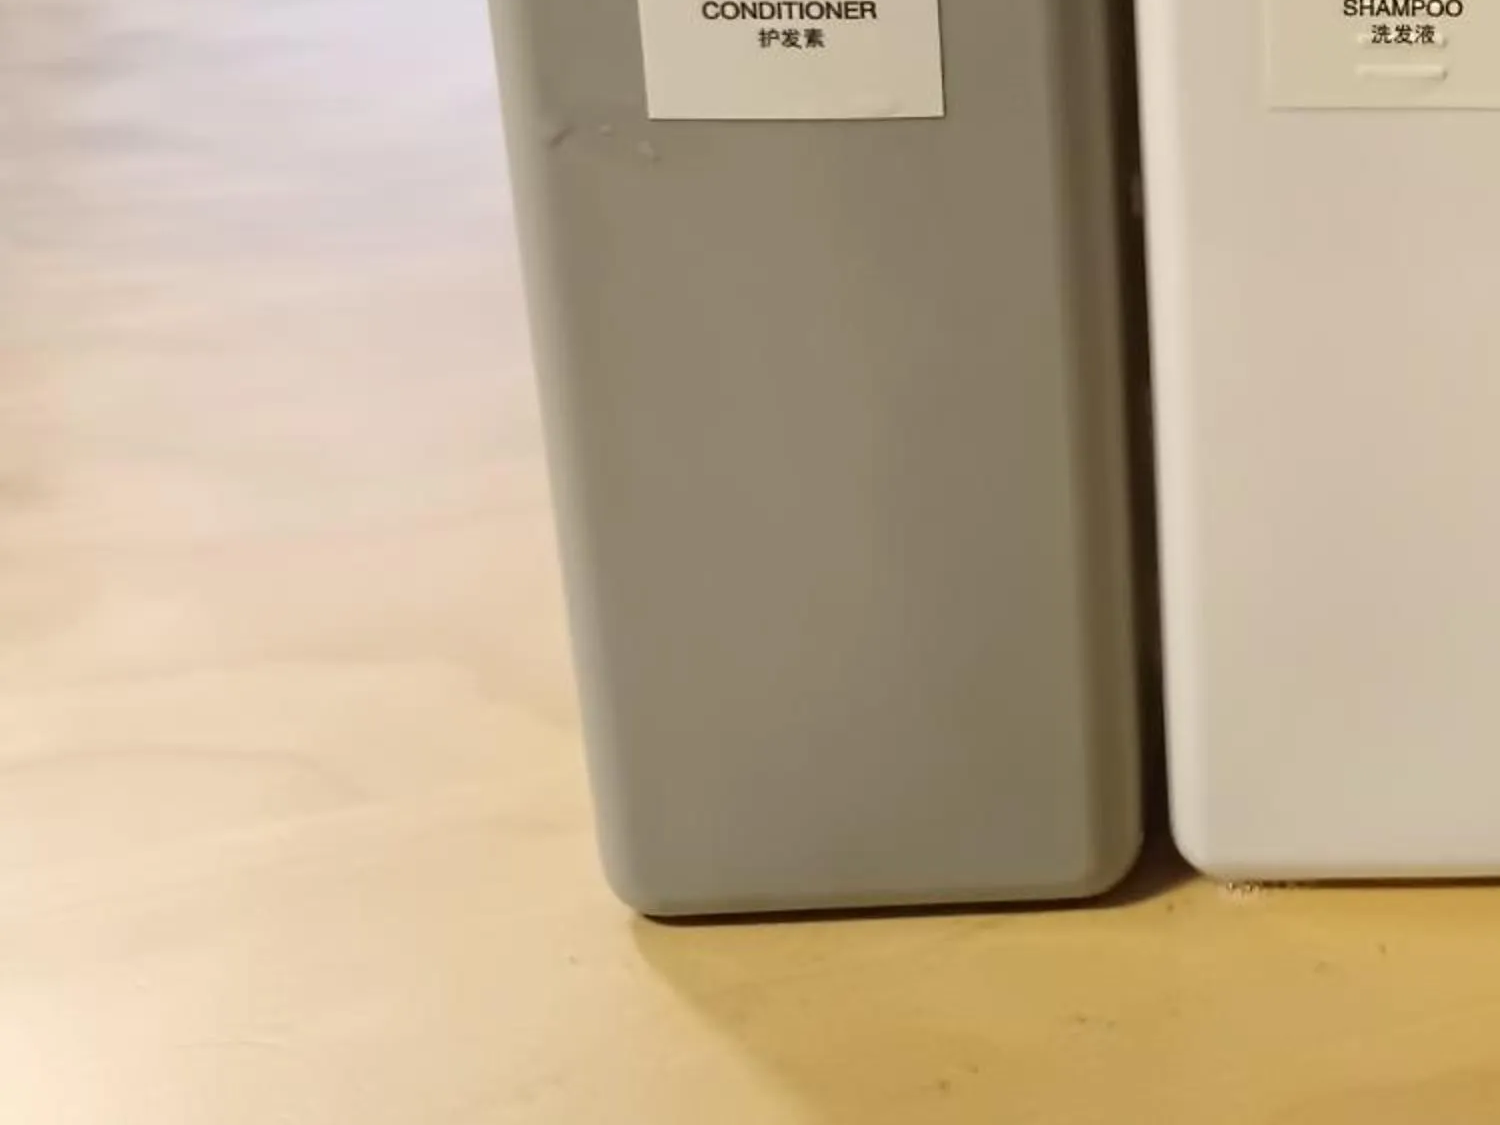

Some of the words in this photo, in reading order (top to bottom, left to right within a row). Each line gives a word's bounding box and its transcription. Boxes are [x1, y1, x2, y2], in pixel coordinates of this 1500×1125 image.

[701, 0, 878, 21] CONDITIONER
[758, 28, 826, 50] 护发素
[1370, 24, 1436, 45] 洗发液
